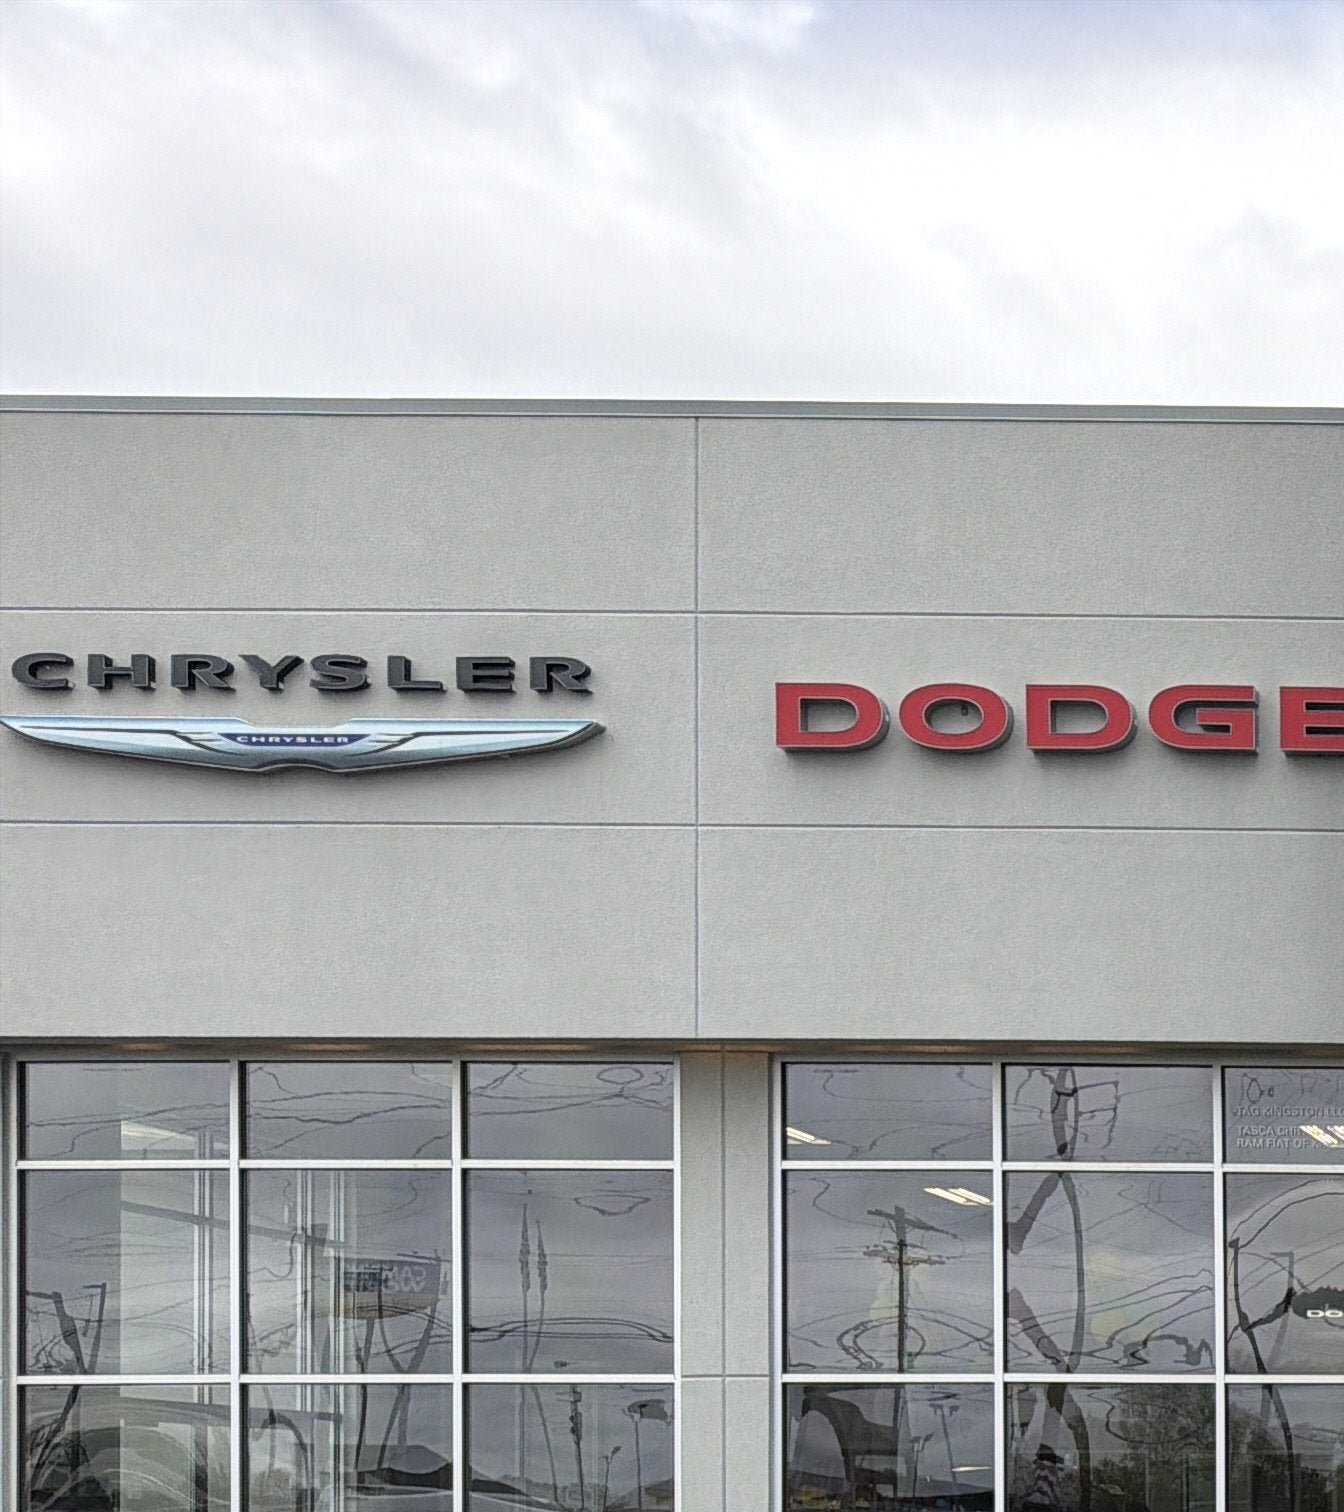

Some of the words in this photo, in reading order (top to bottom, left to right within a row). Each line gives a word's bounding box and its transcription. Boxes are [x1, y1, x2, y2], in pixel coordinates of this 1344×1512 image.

[11, 652, 594, 695] CHRYSLER
[236, 735, 348, 744] CHRYSLER
[1237, 1126, 1273, 1136] TASCA
[1237, 1139, 1263, 1148] RAM
